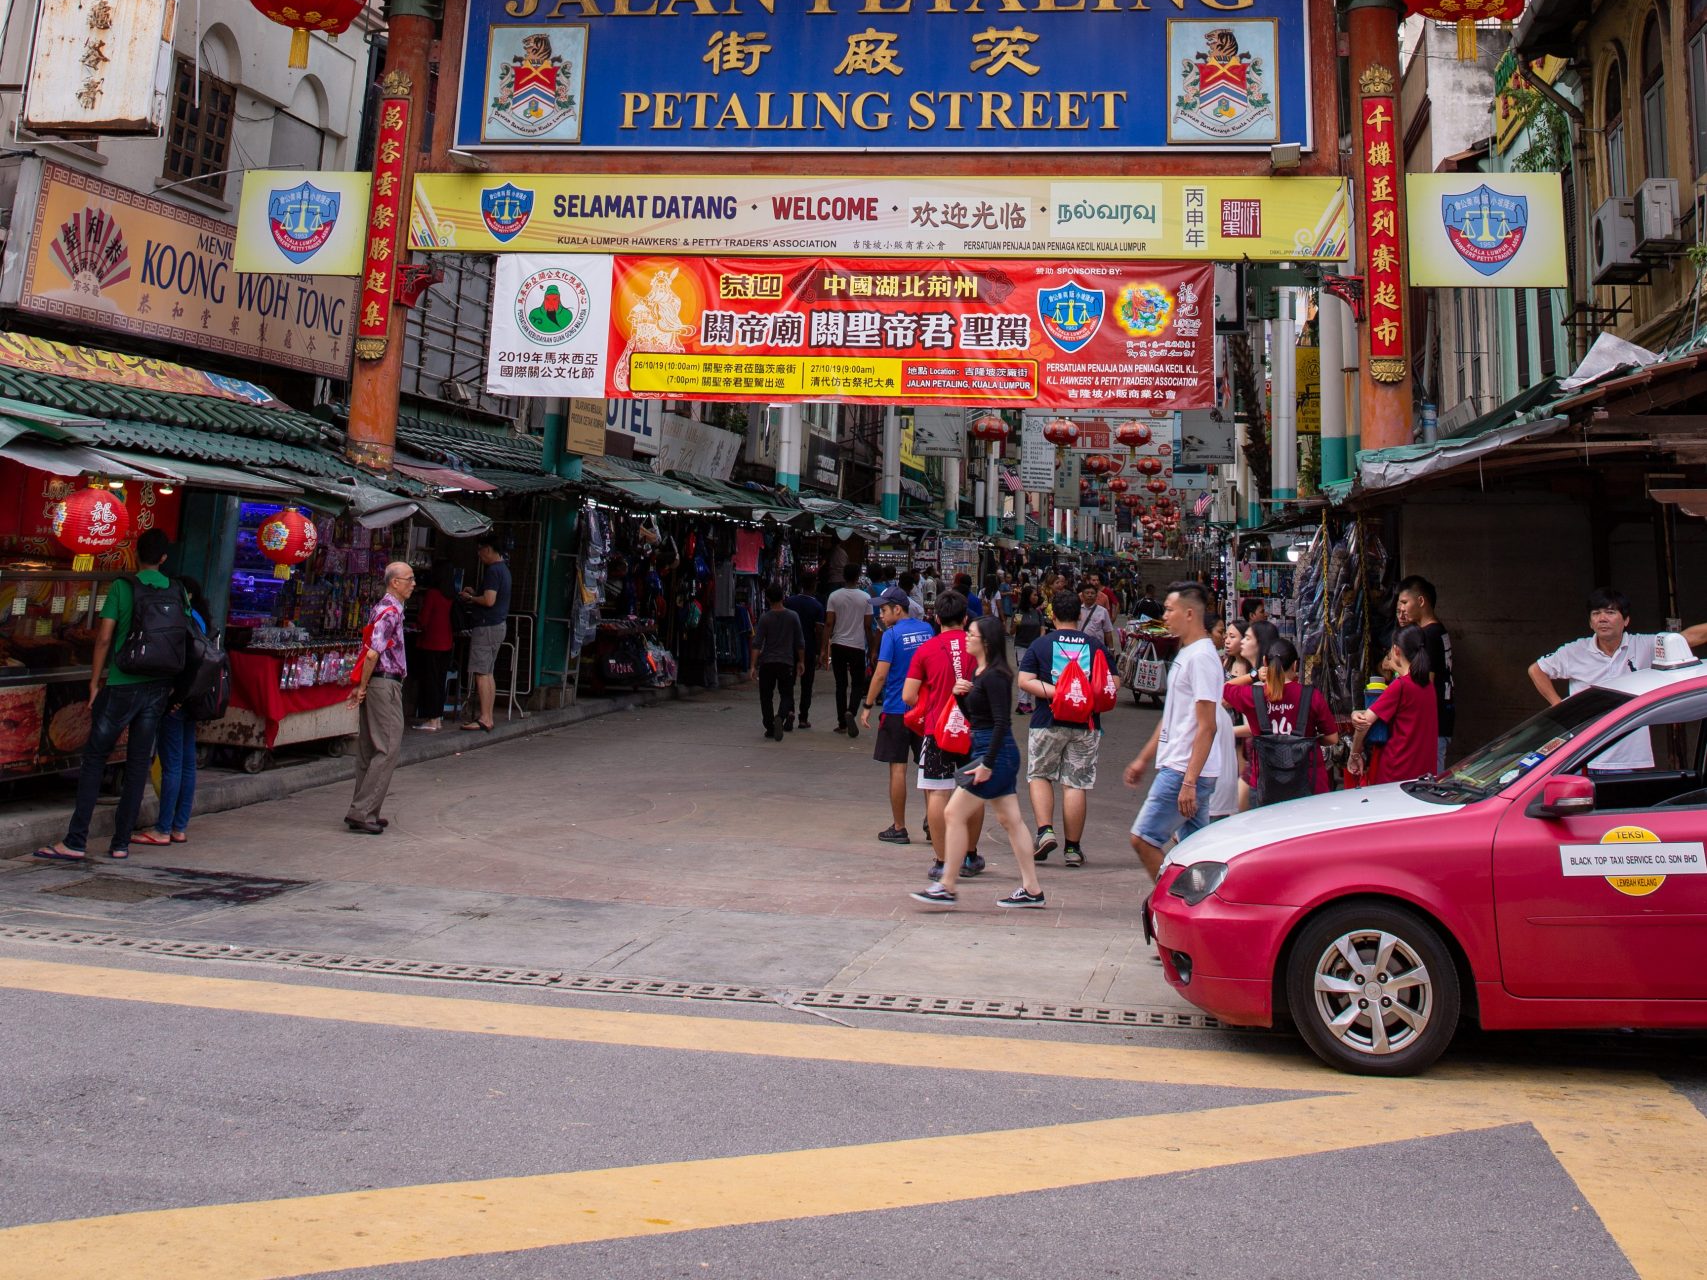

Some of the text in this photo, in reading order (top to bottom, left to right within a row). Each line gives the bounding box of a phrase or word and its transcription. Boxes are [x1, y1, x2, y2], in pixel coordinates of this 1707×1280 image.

[620, 91, 1127, 130] PETALING STREET
[1232, 121, 1247, 131] Kuala
[553, 195, 879, 221] SELAMAT DATANG WELCOME
[1057, 200, 1156, 224] நல்வரவு
[911, 201, 1027, 230] 欢迎光临
[1185, 188, 1205, 248] 丙申年
[557, 237, 589, 245] KUALA
[591, 237, 629, 246] LUMPUR
[682, 238, 689, 246] &
[692, 238, 721, 246] PETTY
[773, 239, 837, 248] ASSOCIATION
[964, 241, 1146, 251] PERSATUAN PENJAJA DAN PENIAGA KECIL KUALA LUMPUR
[1467, 243, 1509, 255] KUALA LUMPUR
[141, 240, 227, 304] KOONG
[238, 273, 289, 320] WOH
[296, 287, 345, 336] TONG
[721, 274, 783, 299] 恭迎
[702, 311, 1031, 349] 關帝廟 關聖帝君 聖駕
[498, 351, 598, 366] 2019年馬來西亞
[500, 366, 594, 379] 國際關公文化節
[1046, 363, 1198, 373] PERSATUAN PENJAJA DAN PENIAGA KECIL K.L.
[667, 375, 699, 384] (7:00pm)
[811, 376, 895, 388] 清代仿古祭祀大典
[906, 380, 1030, 390] JALAN PETALING, KUALA LUMPUR
[1046, 377, 1058, 385] K.L.
[1095, 377, 1100, 385] &
[1101, 377, 1121, 386] PETTY
[1155, 378, 1198, 386] ASSOCIATION
[88, 501, 117, 536] 龍記
[1059, 635, 1085, 643] DAMN
[1272, 716, 1292, 735] 14
[1616, 831, 1644, 839] TEKSI
[1570, 854, 1697, 865] BLACK TOP TAXI SERVICE CO. SDN BHD
[1617, 878, 1657, 887] LEMBAH KELANG
